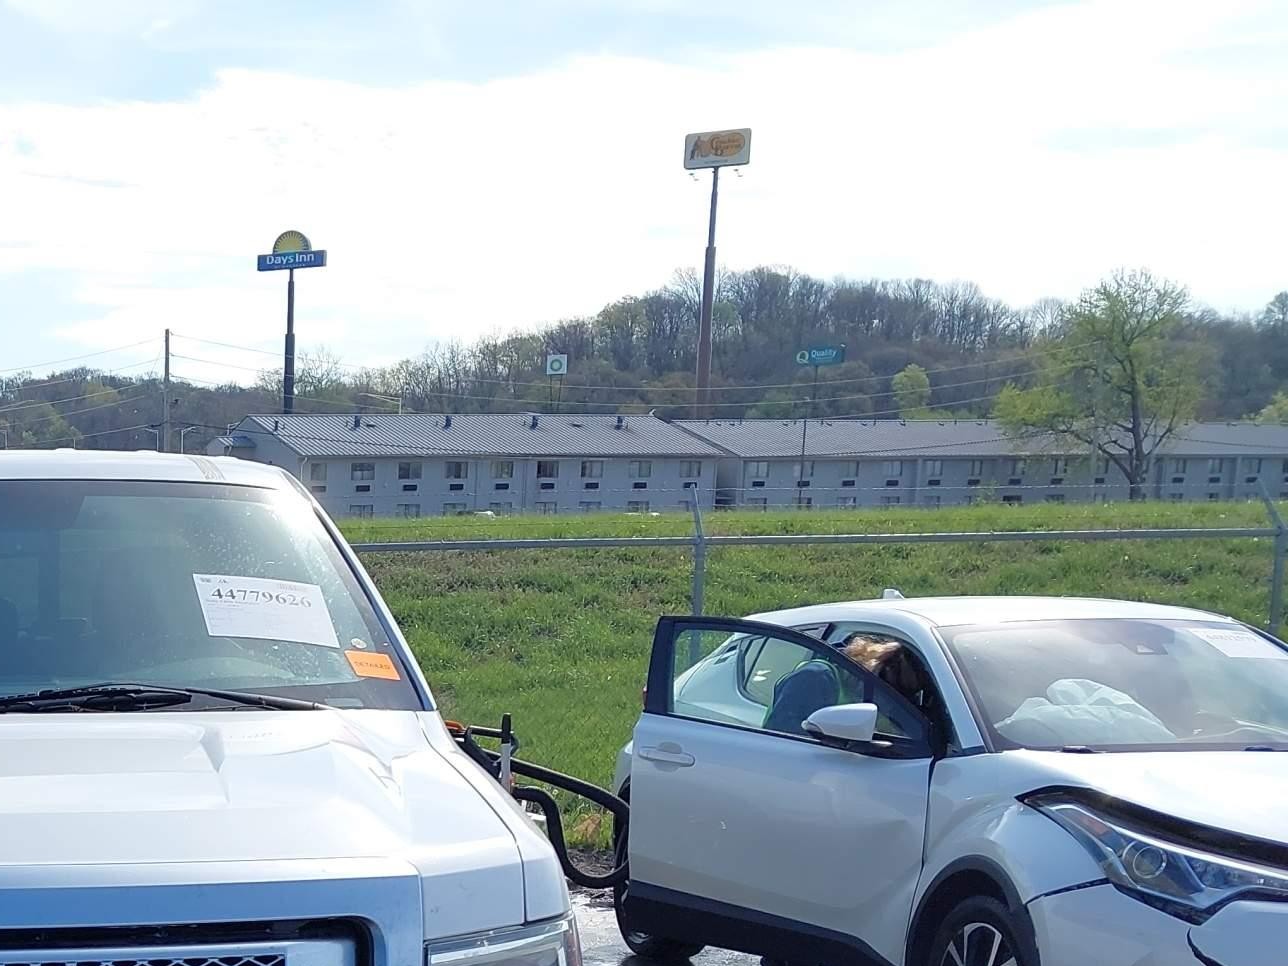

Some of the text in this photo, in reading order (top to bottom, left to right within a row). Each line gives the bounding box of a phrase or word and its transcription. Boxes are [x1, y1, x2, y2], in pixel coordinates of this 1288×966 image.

[266, 253, 314, 265] Days Inn
[811, 349, 837, 358] Quality
[211, 587, 312, 608] 44779626
